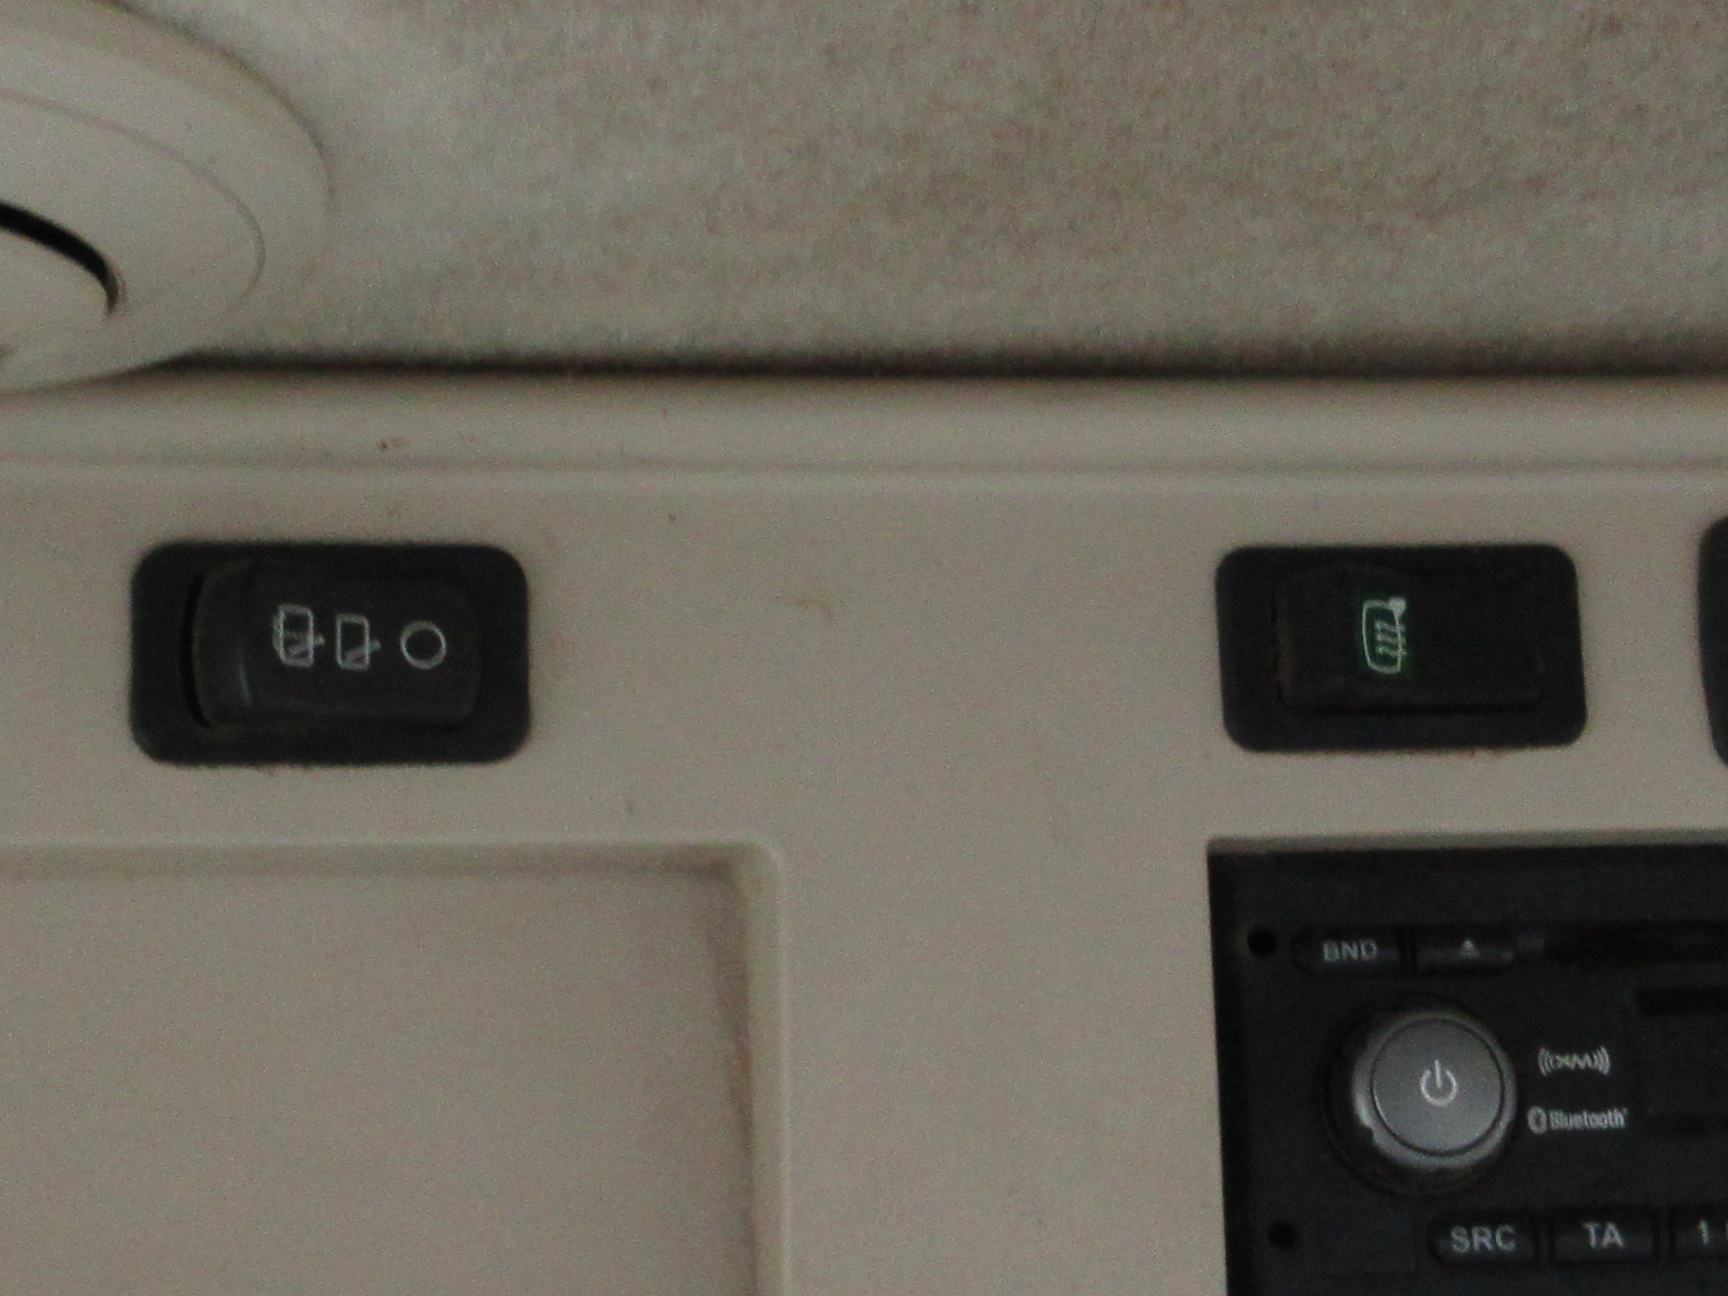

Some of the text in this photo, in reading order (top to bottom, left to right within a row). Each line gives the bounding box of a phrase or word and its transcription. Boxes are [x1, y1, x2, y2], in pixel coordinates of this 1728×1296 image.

[1322, 938, 1377, 962] BND
[1549, 1108, 1626, 1131] Bluetooth
[1450, 1225, 1517, 1254] SRC
[1583, 1222, 1623, 1250] TA
[1697, 1219, 1711, 1245] 1
